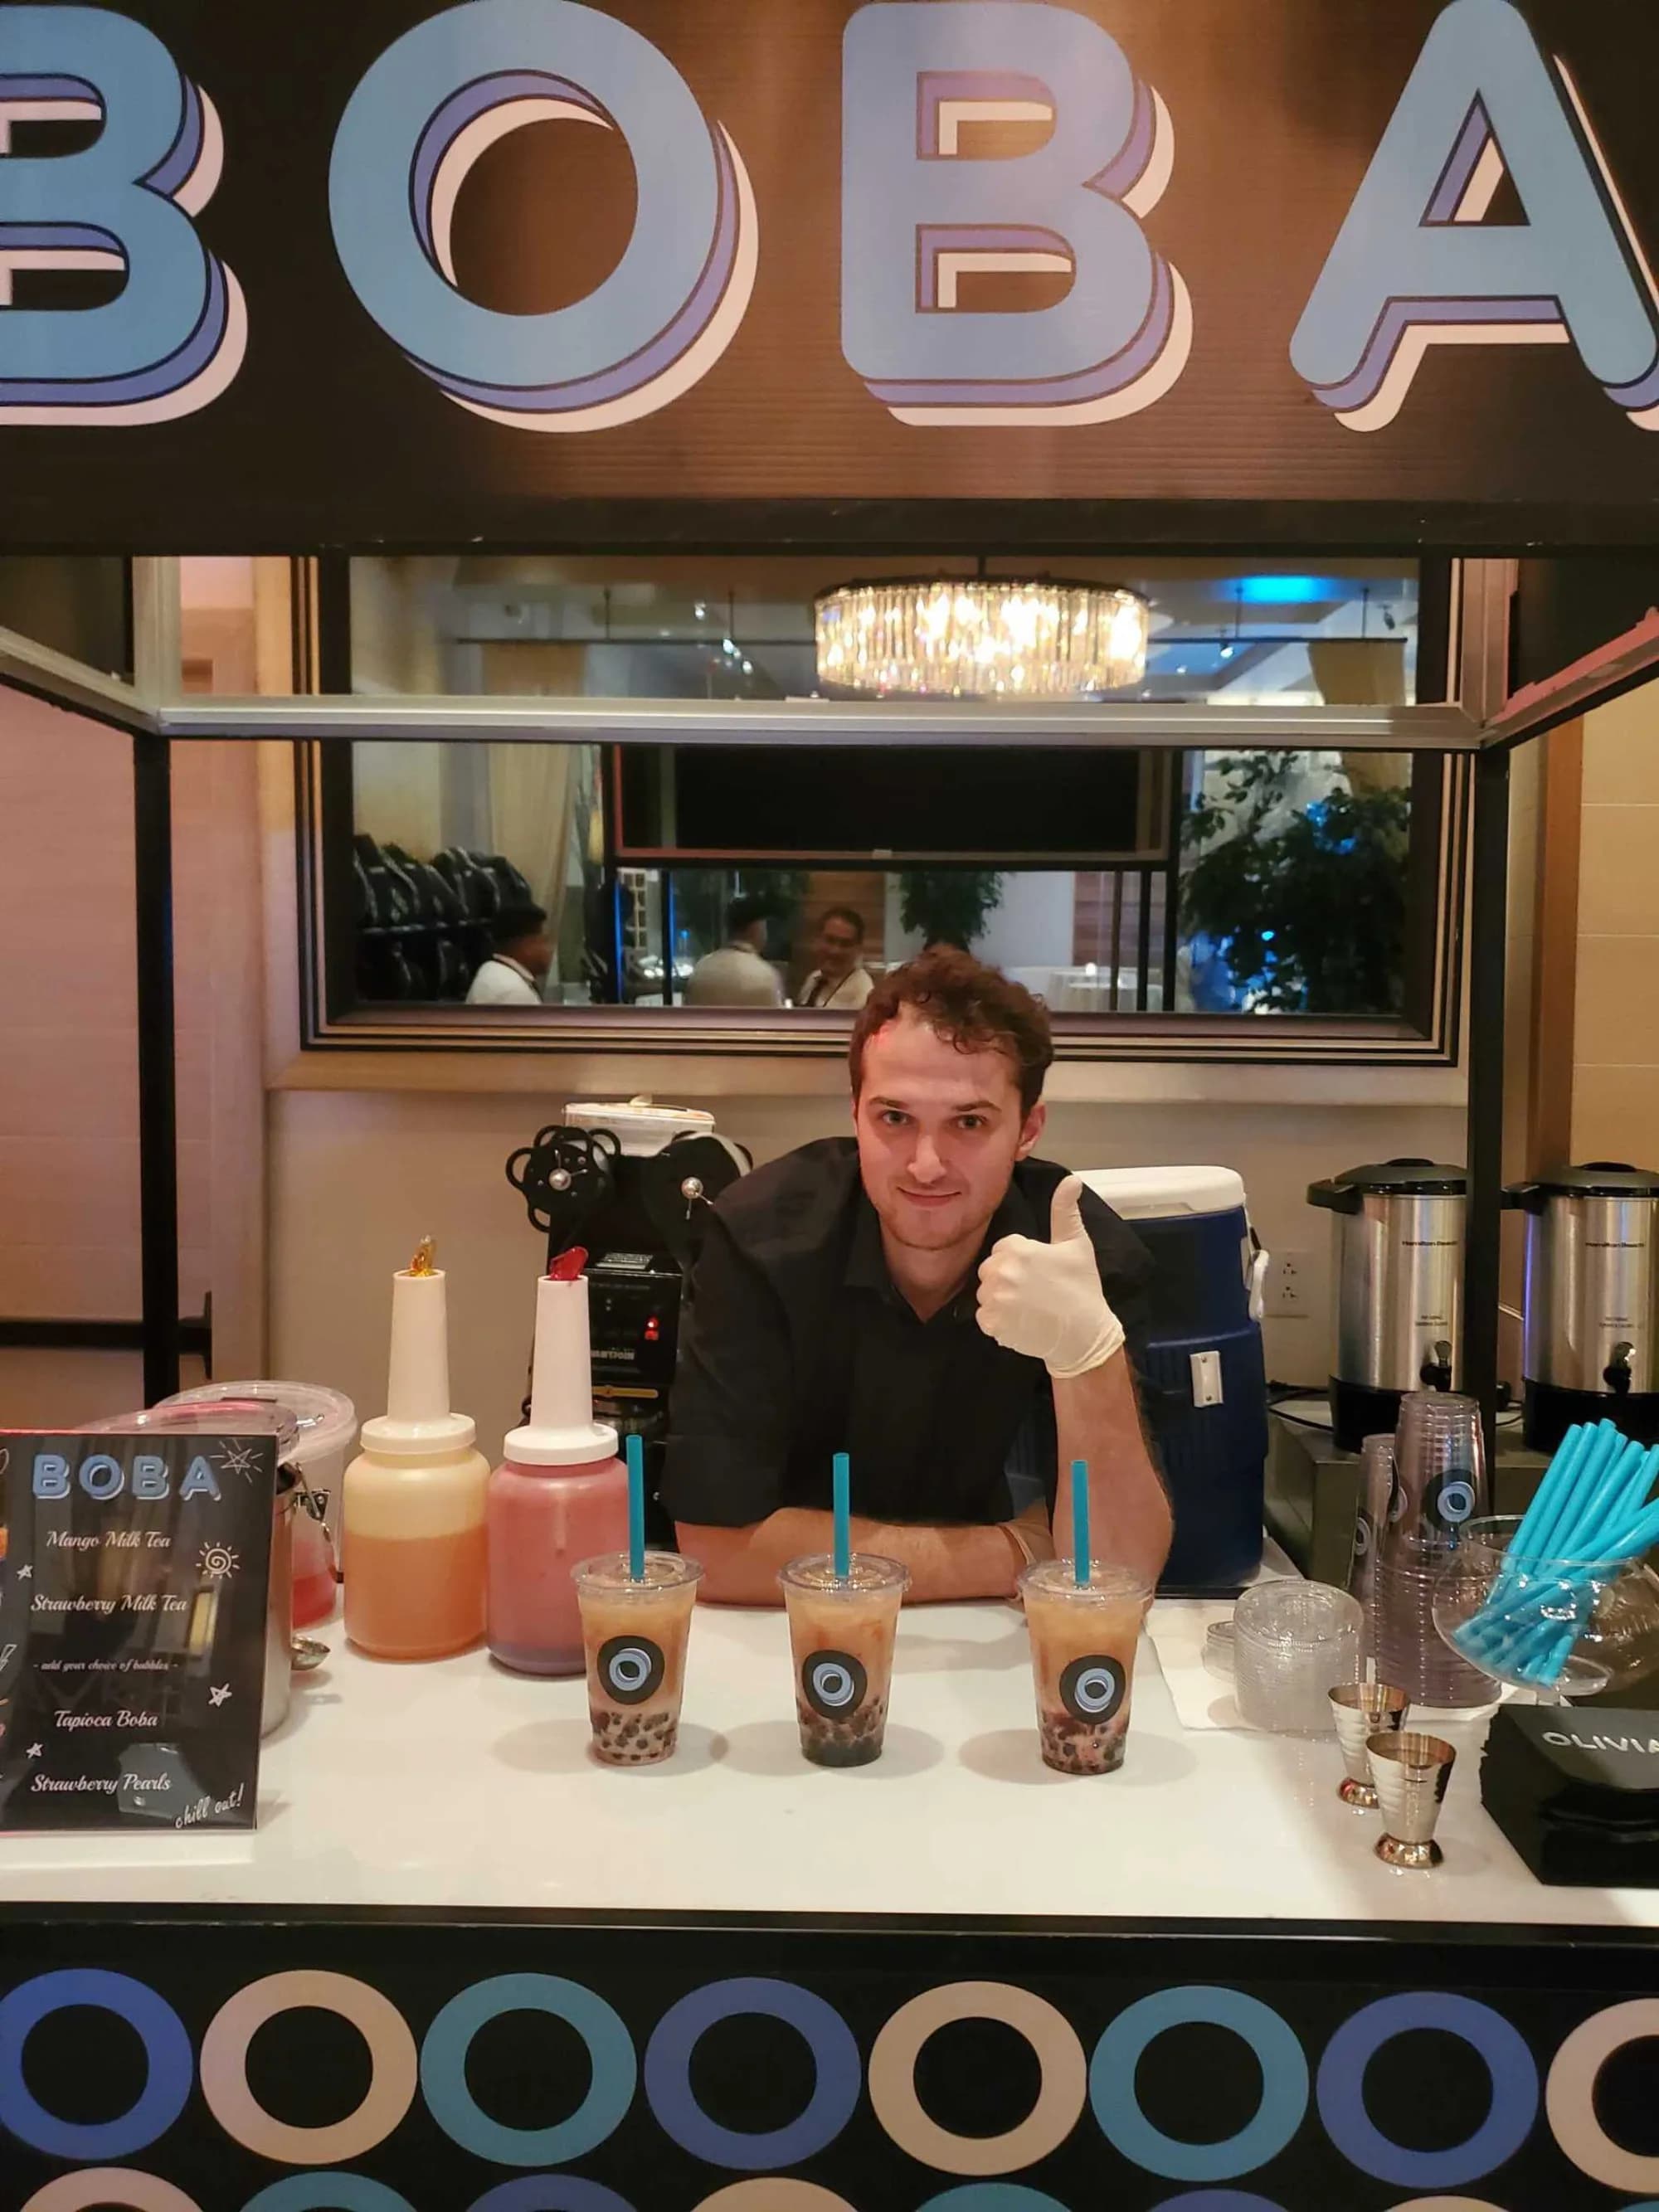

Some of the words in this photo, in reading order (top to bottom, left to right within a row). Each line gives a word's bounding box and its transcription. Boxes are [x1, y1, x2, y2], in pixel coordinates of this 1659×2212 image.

[0, 0, 1659, 432] BOBA
[32, 1454, 222, 1501] BOBA
[46, 1531, 100, 1551] Mango
[105, 1530, 142, 1548] Milk
[144, 1531, 172, 1548] Tea
[31, 1593, 116, 1615] Strawberry
[120, 1594, 158, 1612] Milk
[161, 1594, 187, 1611] Tea
[63, 1661, 85, 1673] your
[119, 1659, 134, 1672] of
[54, 1710, 111, 1732] Tapioca
[115, 1709, 159, 1727] Boba
[31, 1774, 118, 1795] Strawberry
[123, 1772, 172, 1791] Pearls
[175, 1796, 211, 1829] chill
[214, 1782, 245, 1814] out!
